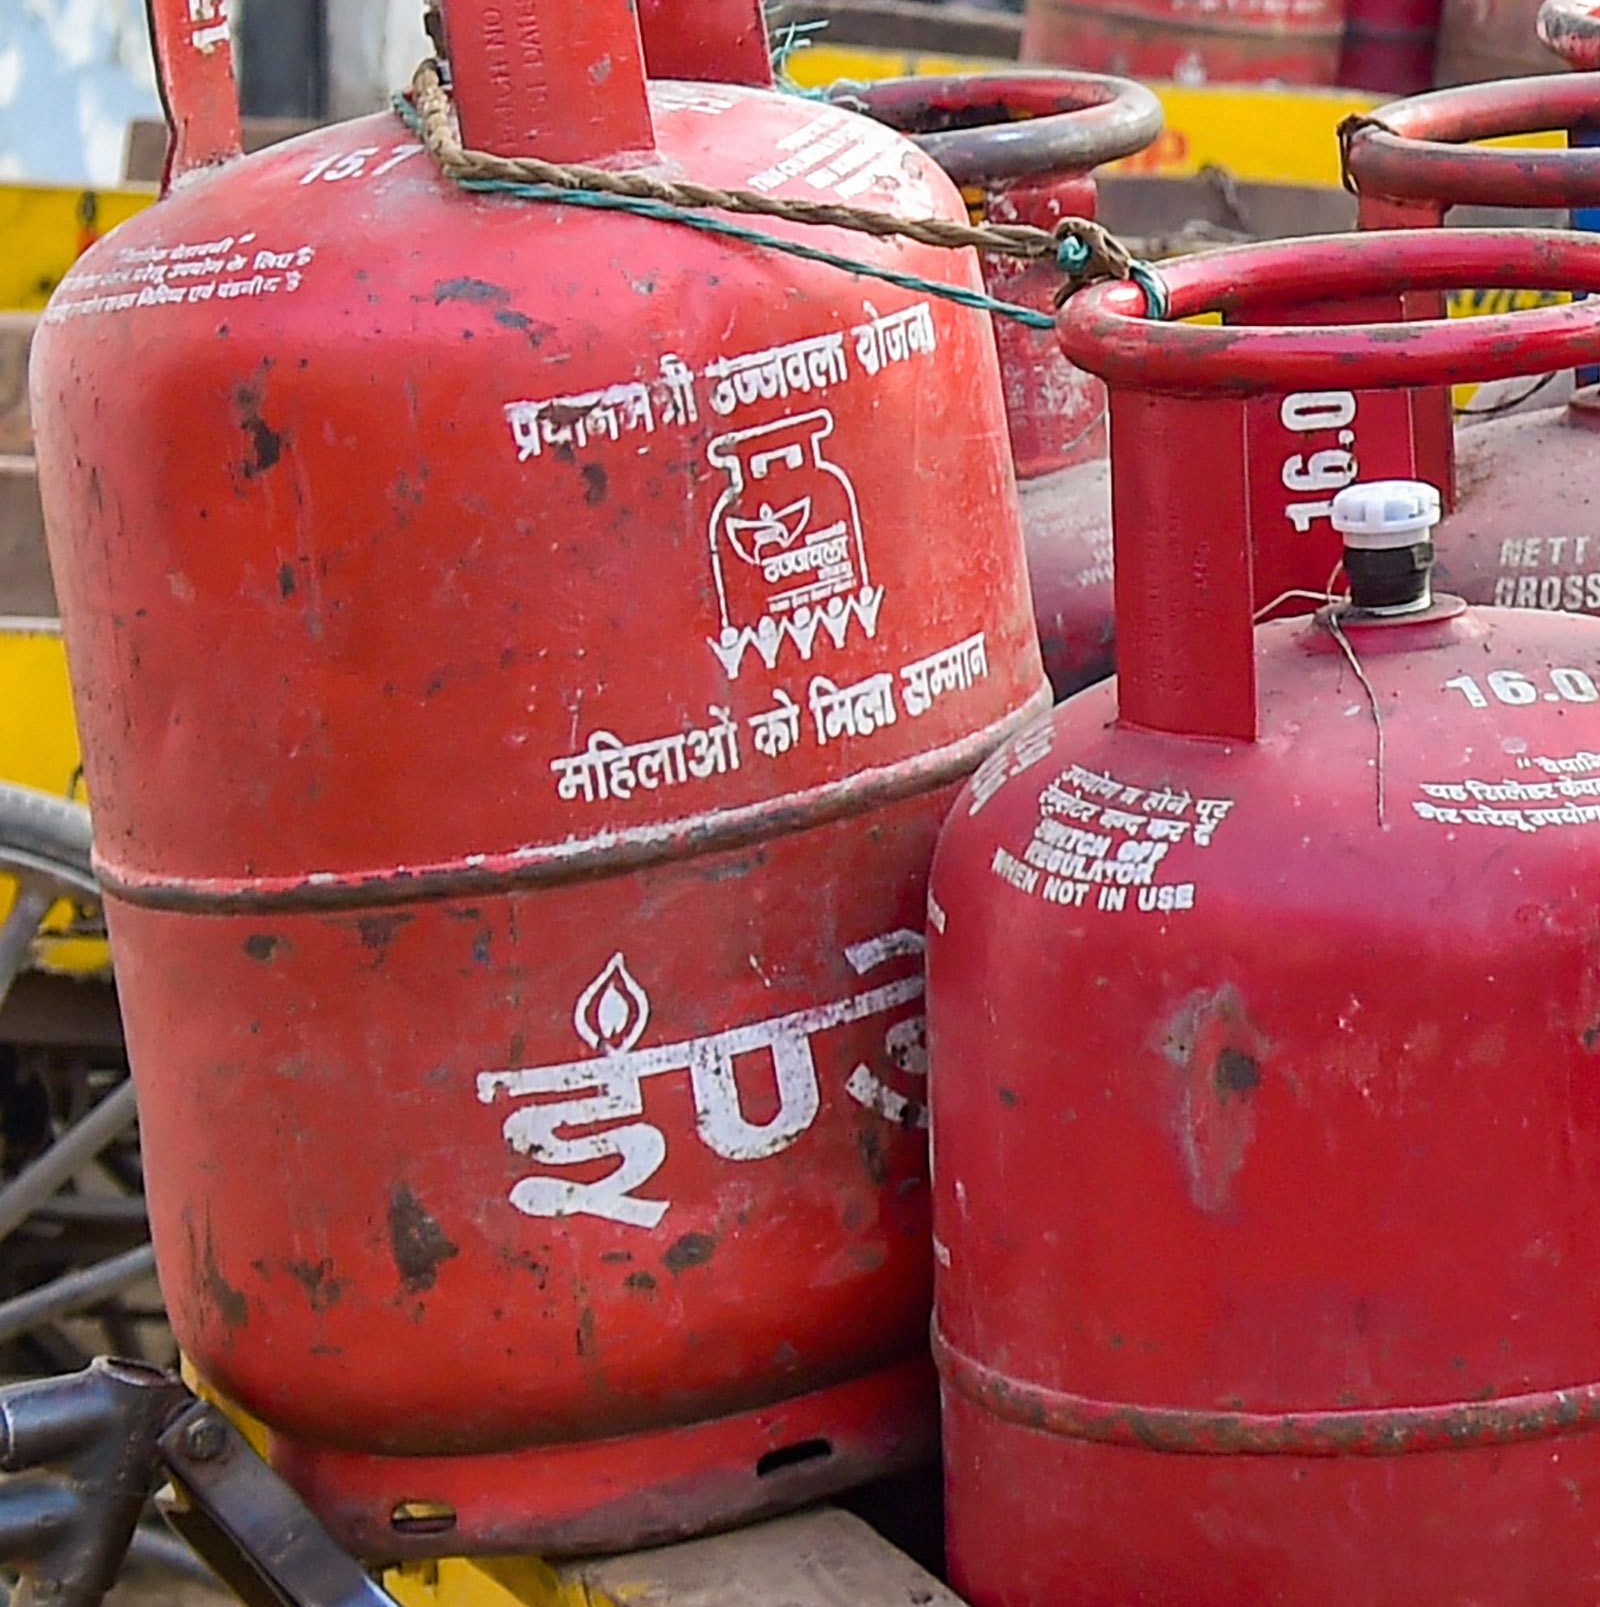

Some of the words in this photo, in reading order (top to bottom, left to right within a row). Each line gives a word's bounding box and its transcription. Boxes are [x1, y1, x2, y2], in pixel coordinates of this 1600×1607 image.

[299, 144, 424, 185] 15.7
[850, 299, 937, 376] योजना
[1281, 390, 1357, 532] 16.0
[1500, 536, 1590, 567] NETT
[550, 705, 741, 803] महिलाओं
[748, 688, 801, 758] को
[808, 674, 897, 745] मिला
[899, 631, 989, 716] सम्मान
[1445, 668, 1600, 708] 16.0
[991, 847, 1040, 894] WHEN
[1042, 874, 1091, 907] NOT
[1098, 886, 1128, 911] IN
[1137, 883, 1196, 911] USE
